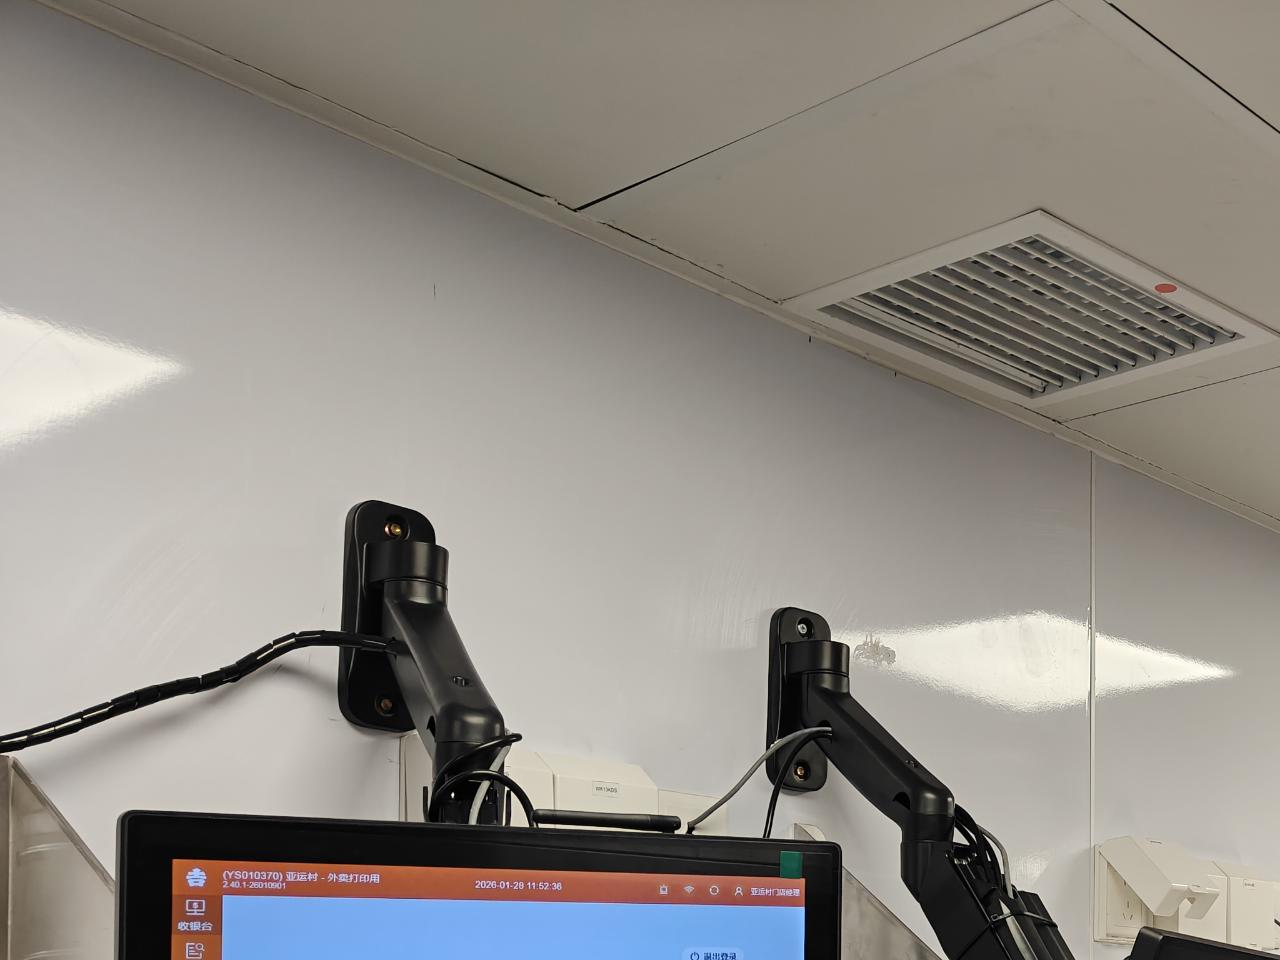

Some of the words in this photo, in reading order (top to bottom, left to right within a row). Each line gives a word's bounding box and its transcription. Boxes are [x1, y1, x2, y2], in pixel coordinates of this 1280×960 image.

[223, 869, 283, 882] (YS010370)
[286, 871, 318, 883] 亚运村
[327, 872, 380, 884] 外卖打印用
[475, 879, 524, 890] 2026-01-28
[526, 881, 562, 891] 11:52:36
[177, 921, 213, 932] 收银台
